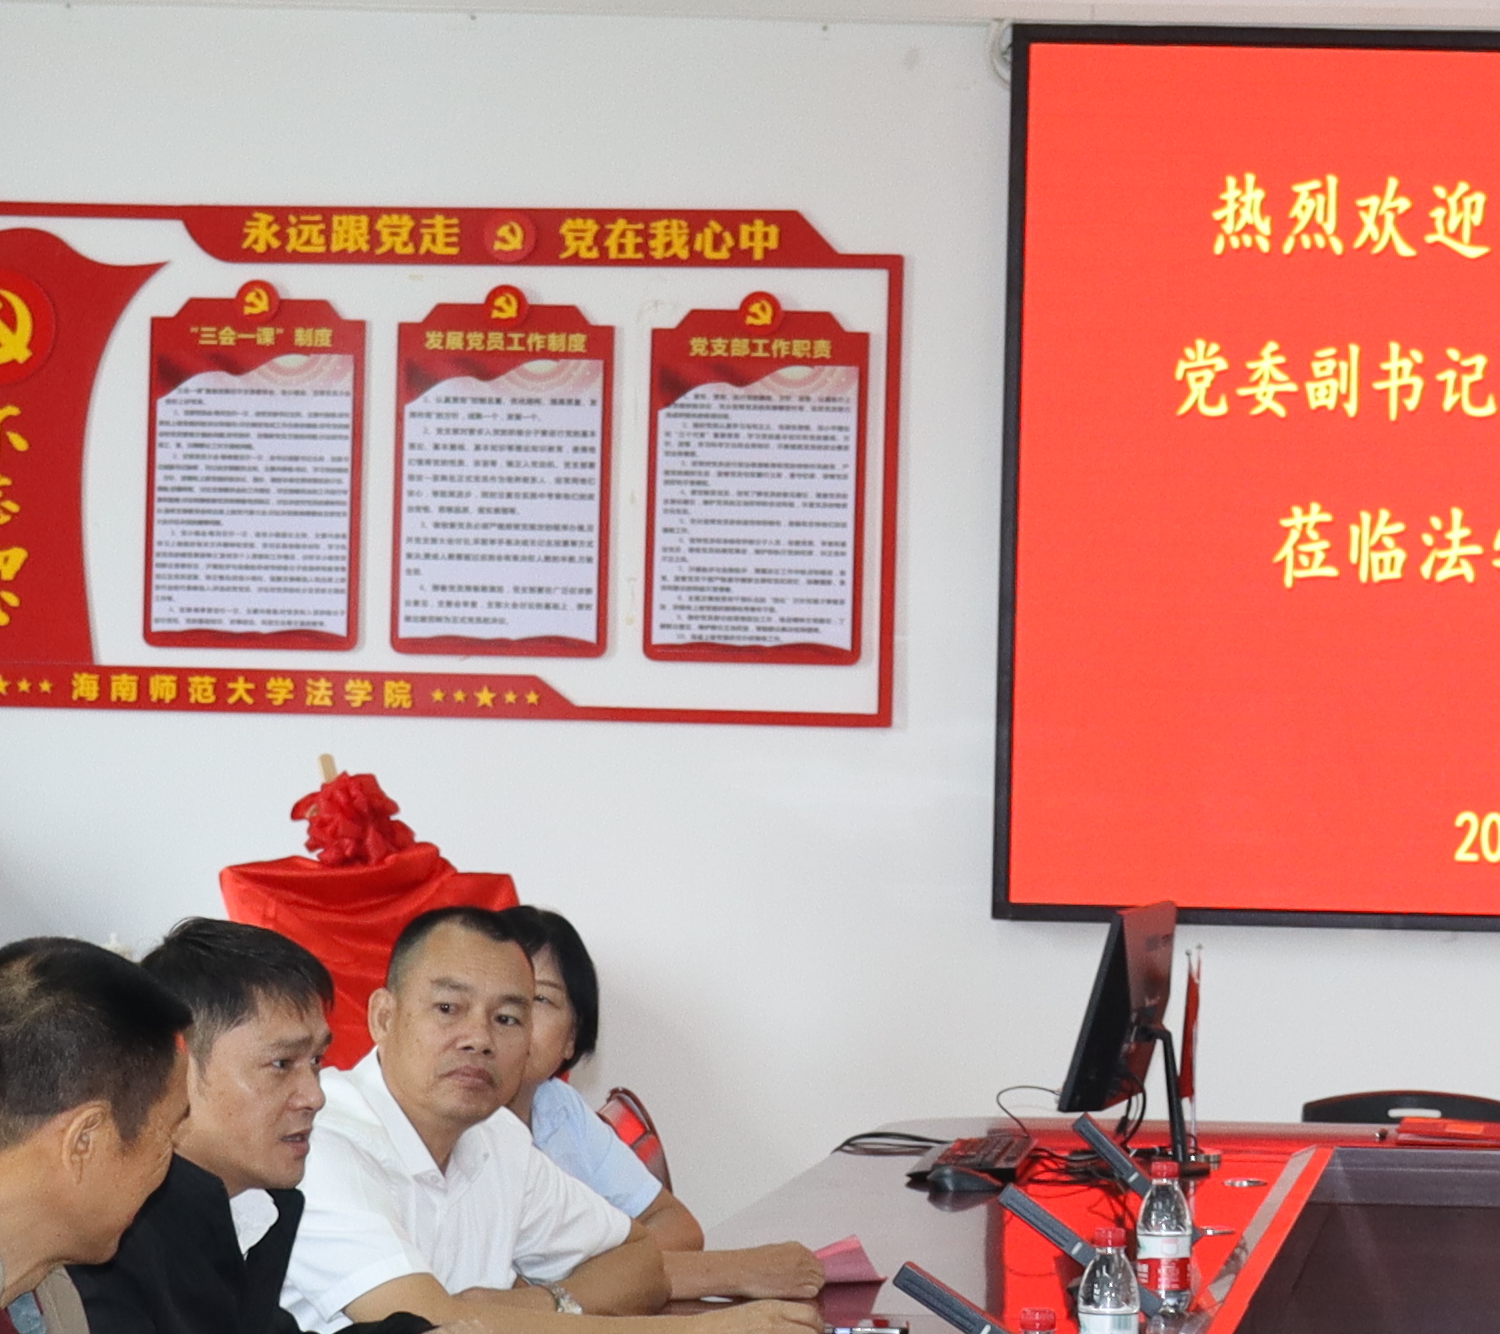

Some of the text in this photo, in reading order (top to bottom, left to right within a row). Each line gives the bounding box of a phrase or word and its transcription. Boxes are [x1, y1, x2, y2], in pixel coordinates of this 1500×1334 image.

[241, 211, 780, 261] 永远跟党走 党在我心中
[424, 330, 588, 353] 发展党员工作制度
[689, 337, 832, 359] 党支部工作职责
[70, 672, 414, 709] 海南师范大学法学院
